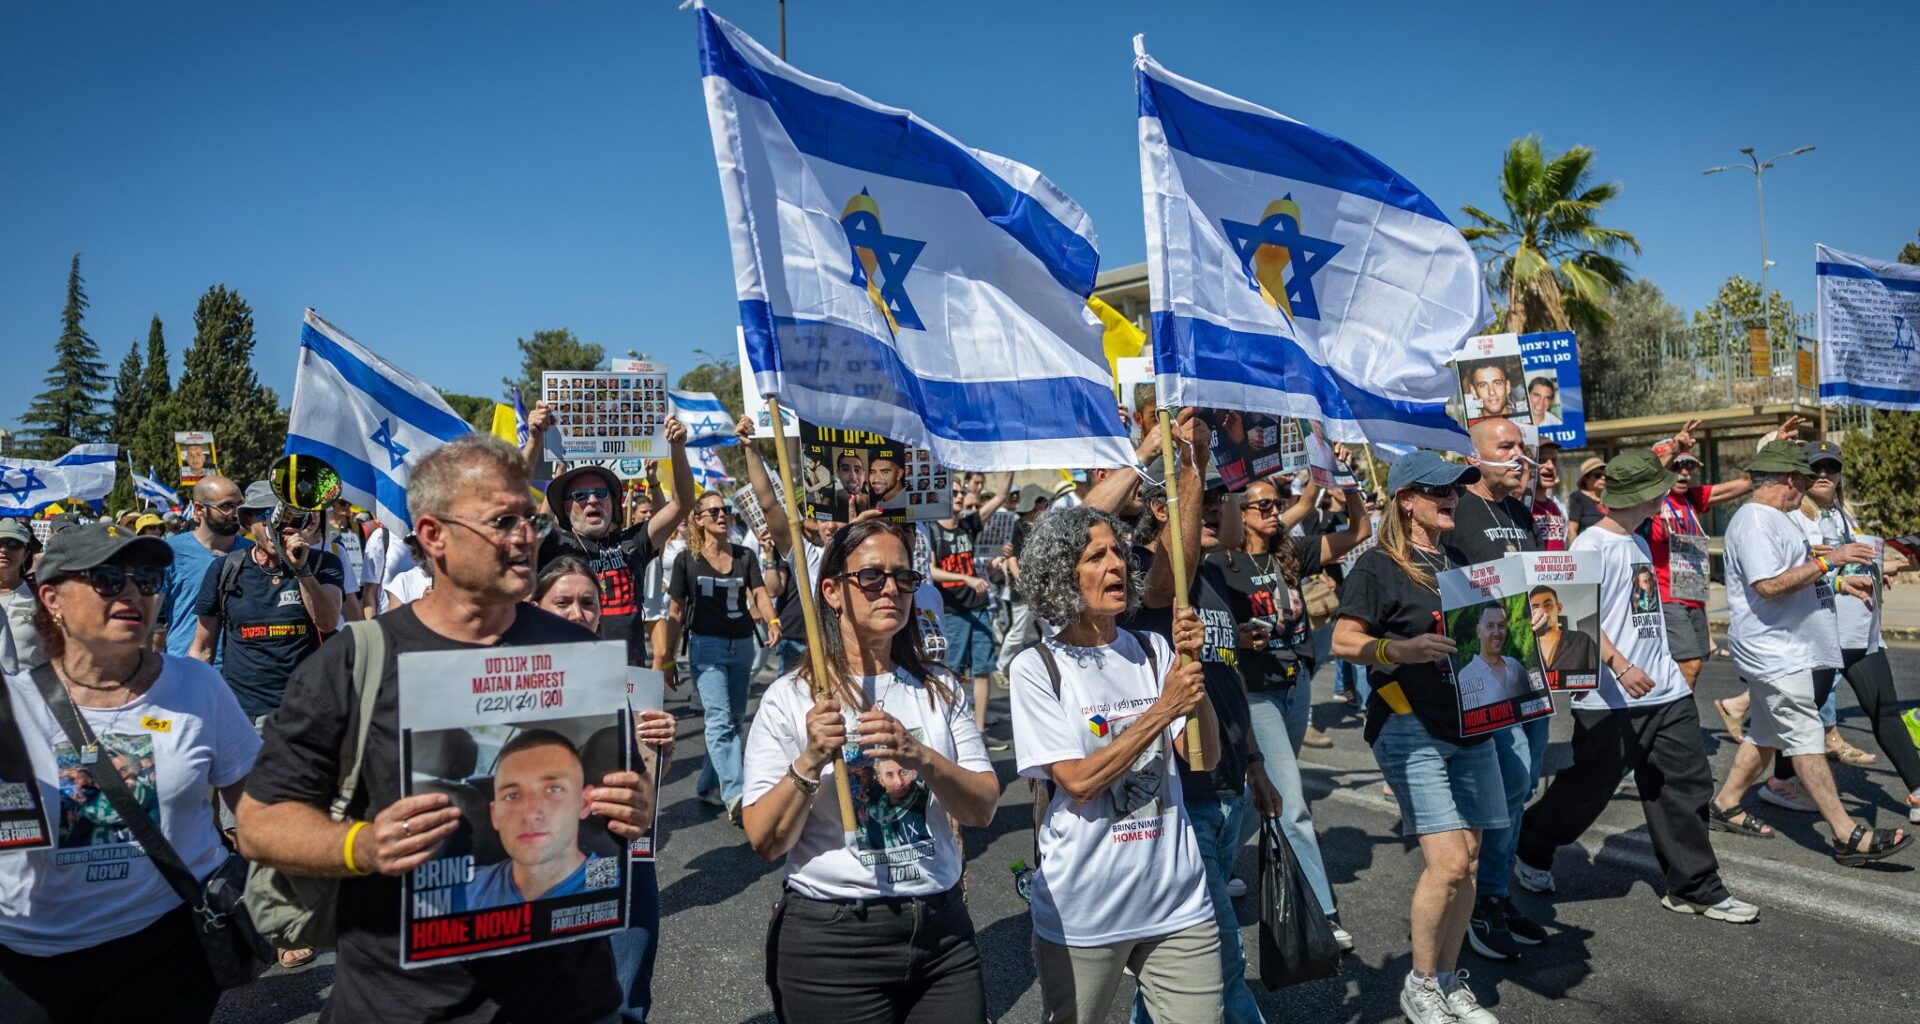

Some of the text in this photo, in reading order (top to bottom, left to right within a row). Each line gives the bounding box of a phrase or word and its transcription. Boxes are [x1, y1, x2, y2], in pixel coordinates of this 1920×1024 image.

[1553, 338, 1569, 349] אין
[1530, 355, 1552, 365] הדר
[1554, 352, 1571, 364] סגן
[1556, 429, 1577, 442] עוז
[600, 440, 625, 454] נקום.
[485, 654, 552, 674] מתן אנגרסט
[472, 671, 565, 694] MATAN ANGREST
[1464, 707, 1489, 729] HOME
[1490, 700, 1515, 722] NOW!
[11, 827, 42, 840] FORUM
[1112, 821, 1136, 833] BRING
[1114, 831, 1143, 843] HOME
[57, 850, 89, 866] BRING
[91, 846, 129, 862] MATAN
[87, 862, 129, 883] NOW!
[413, 855, 475, 890] BRING
[888, 863, 920, 884] NOW!
[413, 888, 451, 919] HIM
[412, 903, 533, 949] HOME NOW!
[551, 908, 618, 931] FAMILIES FORUM
